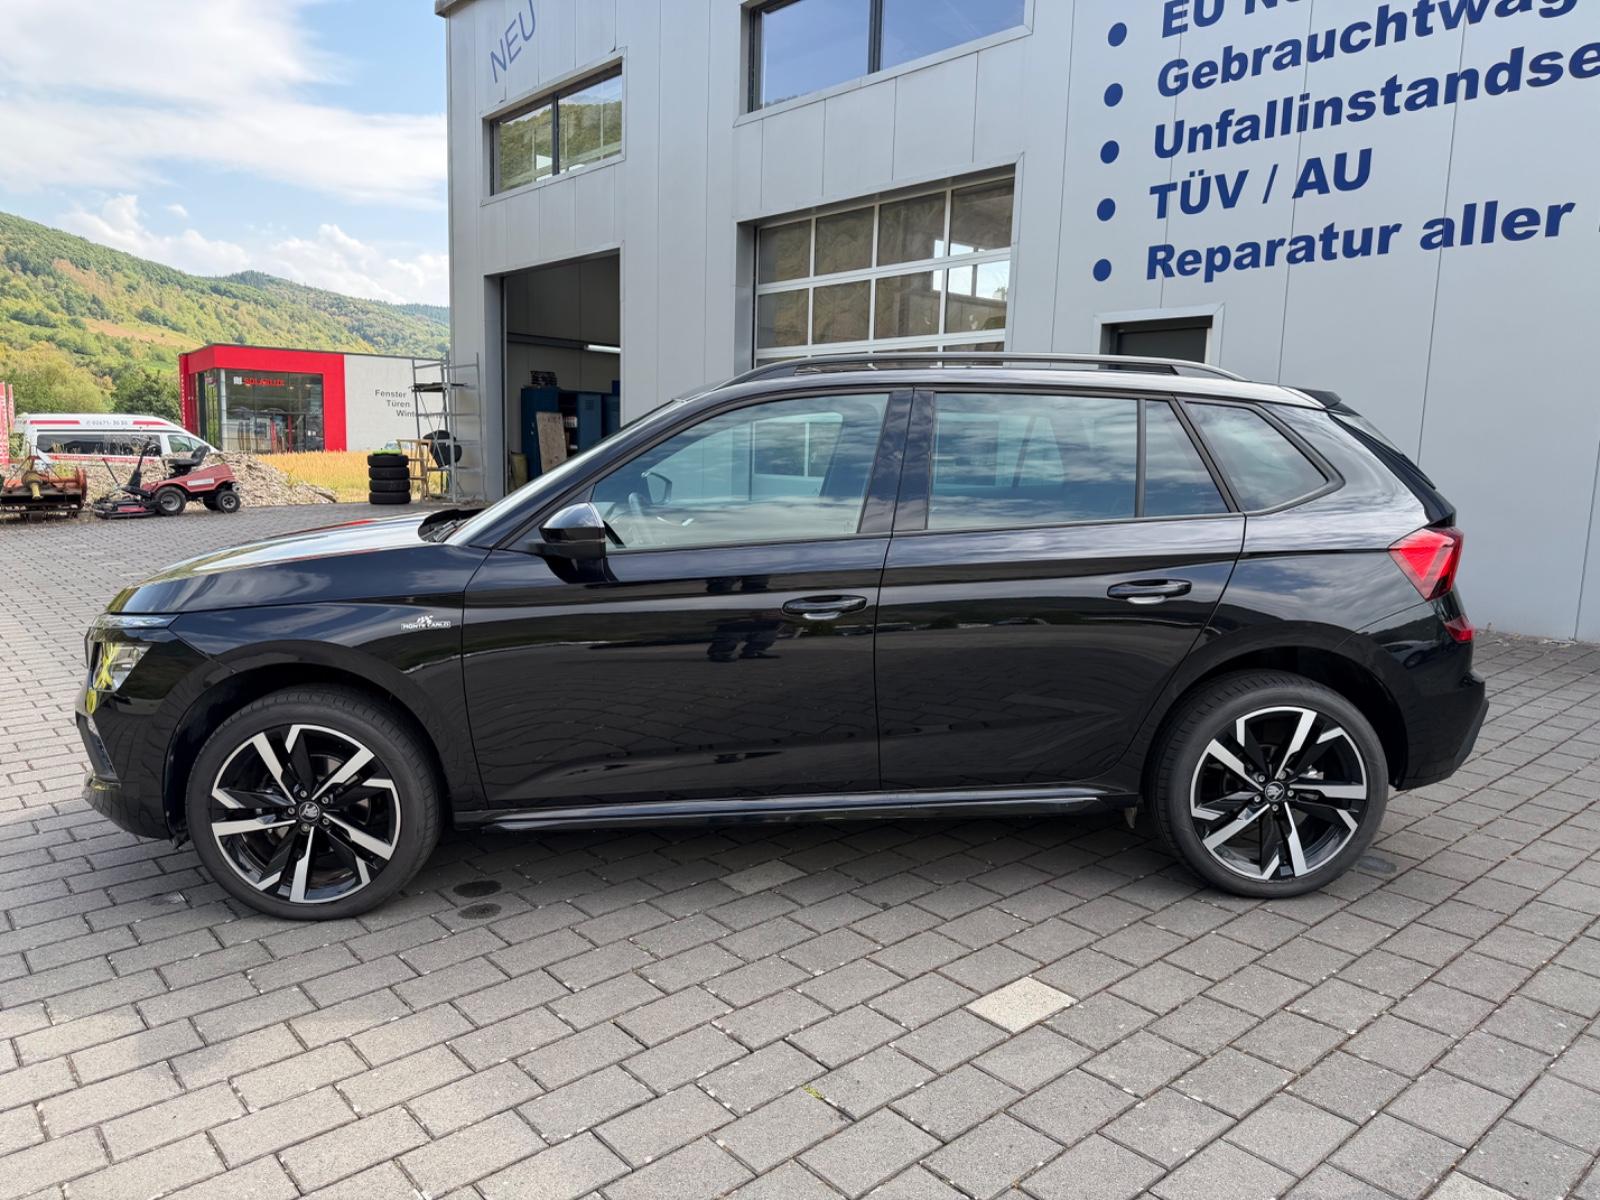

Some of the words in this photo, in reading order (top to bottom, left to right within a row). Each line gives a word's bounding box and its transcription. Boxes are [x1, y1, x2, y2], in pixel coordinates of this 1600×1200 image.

[490, 0, 536, 84] NEU
[1162, 0, 1225, 38] EU
[1150, 169, 1249, 219] TÜV
[1262, 164, 1278, 204] /
[1292, 148, 1372, 199] AU
[1146, 222, 1402, 283] Reparatur
[1420, 200, 1575, 250] aller
[375, 389, 407, 398] Fenster
[386, 399, 410, 407] Türen
